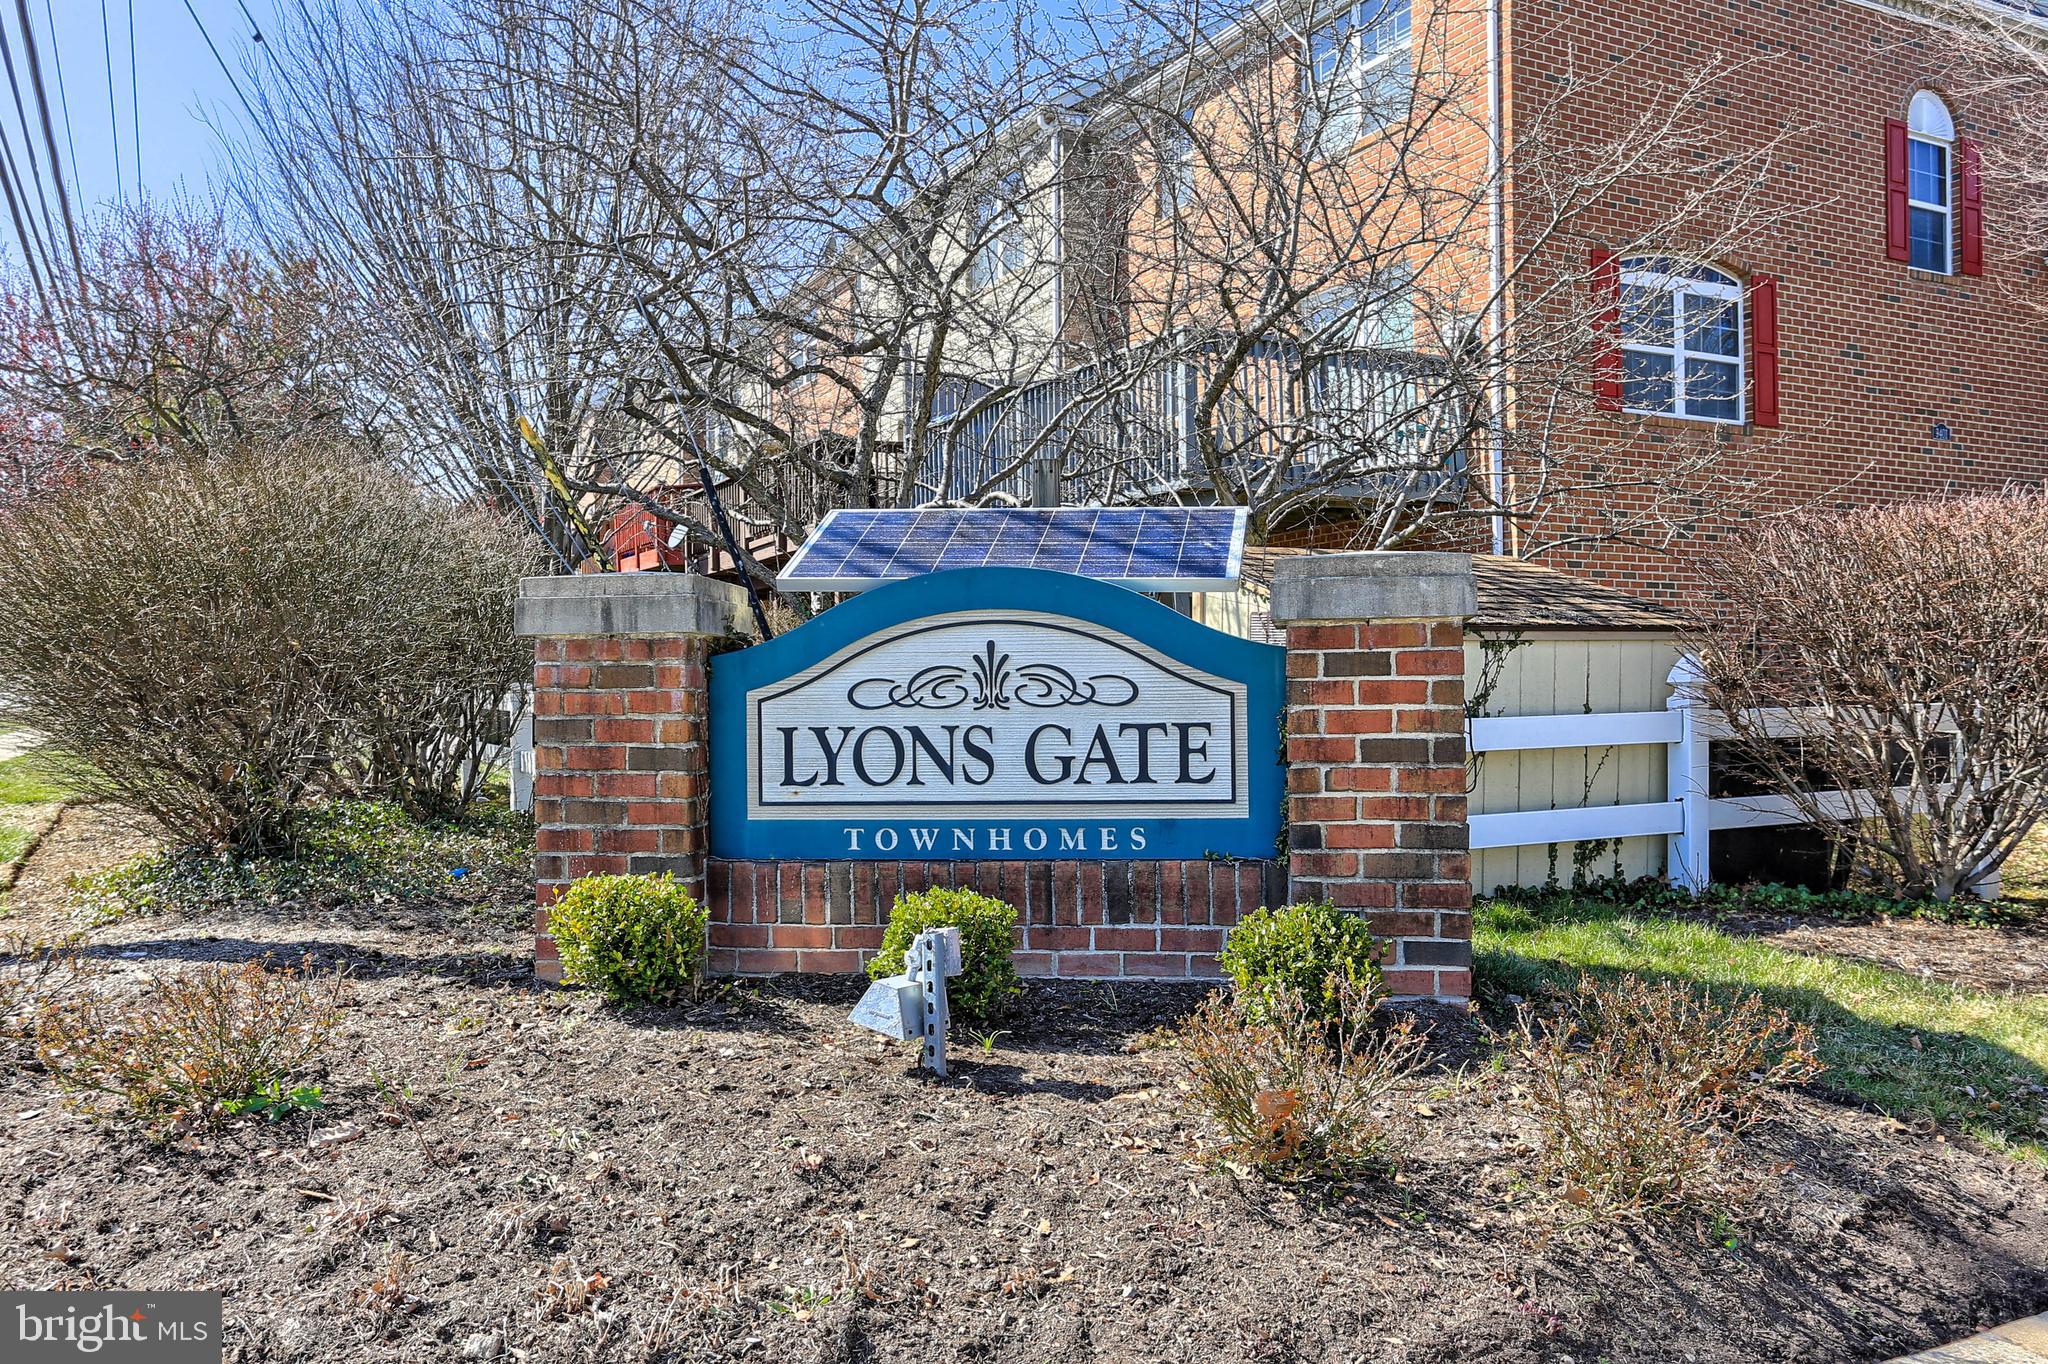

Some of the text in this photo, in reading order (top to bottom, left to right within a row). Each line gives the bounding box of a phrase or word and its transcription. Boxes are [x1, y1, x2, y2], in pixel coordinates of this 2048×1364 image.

[776, 722, 1217, 787] LYONS GATE
[843, 827, 1147, 851] TOWNHOMES
